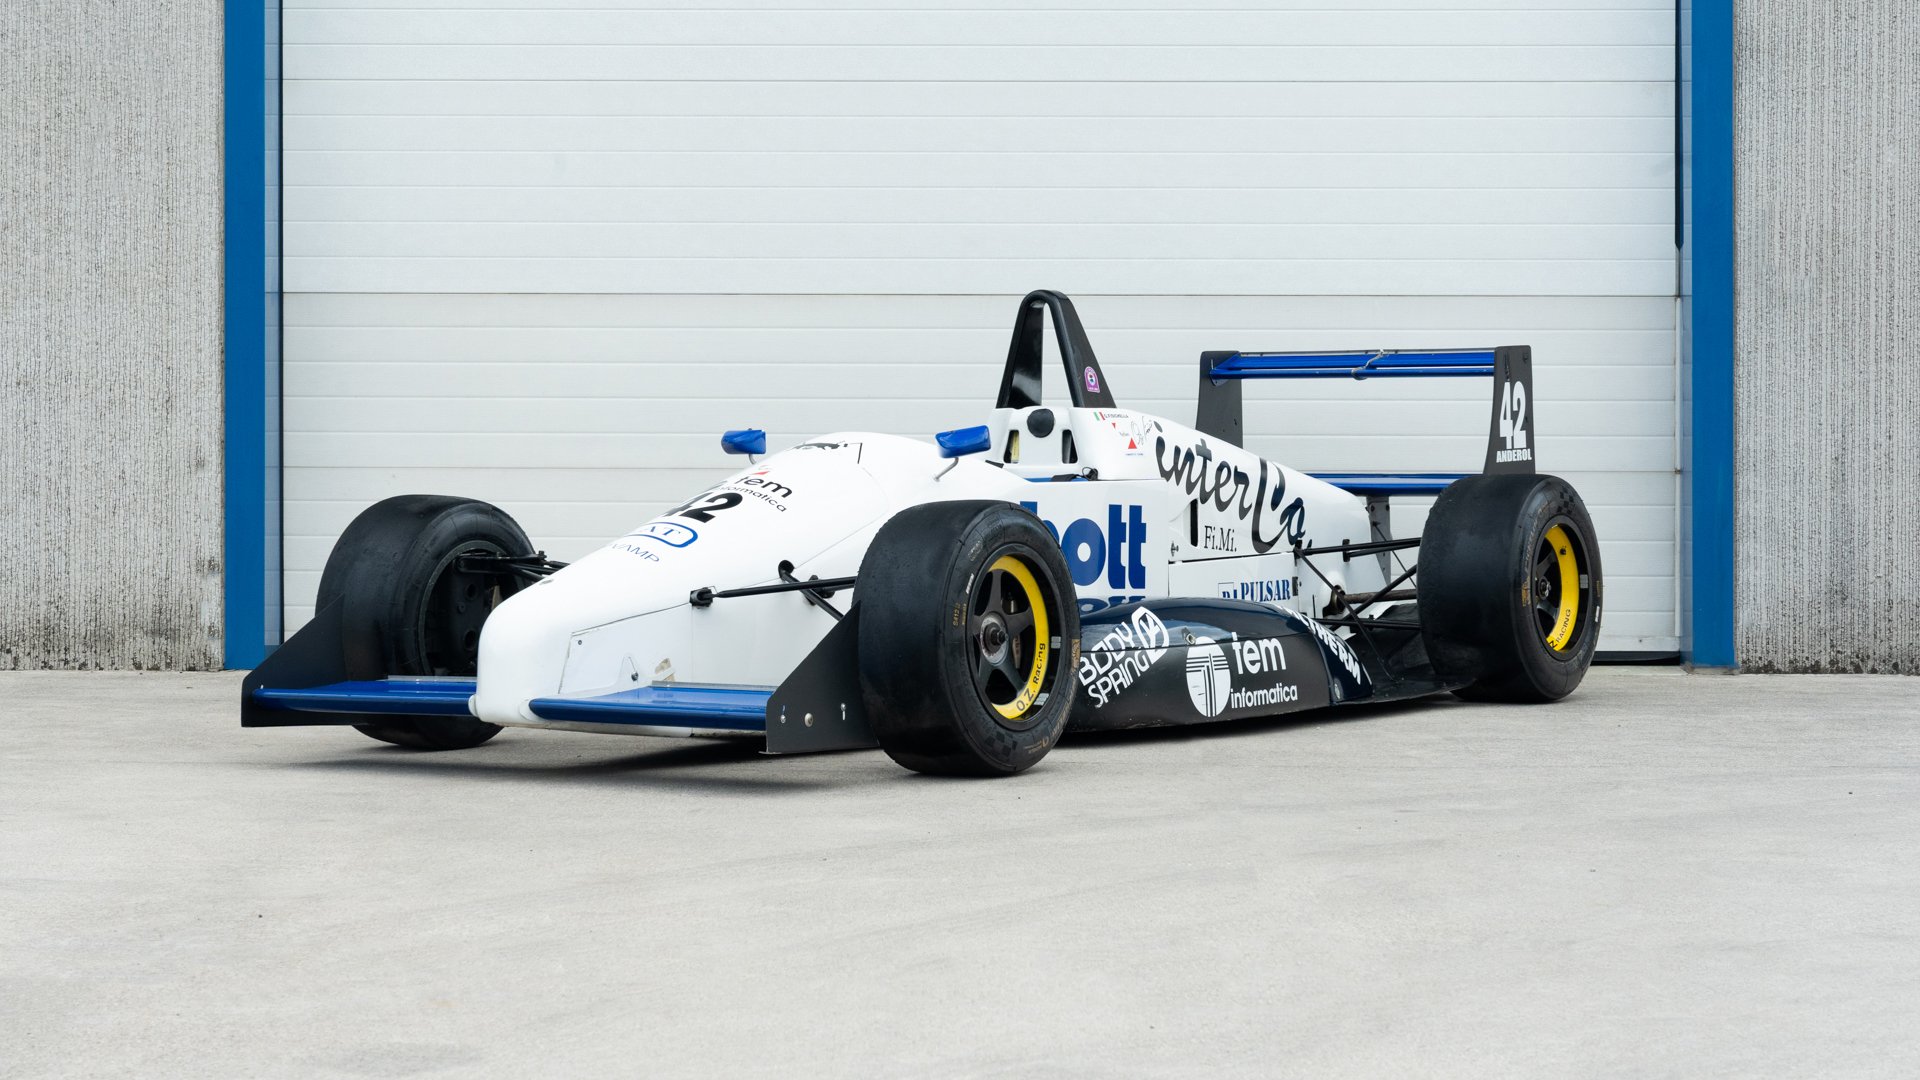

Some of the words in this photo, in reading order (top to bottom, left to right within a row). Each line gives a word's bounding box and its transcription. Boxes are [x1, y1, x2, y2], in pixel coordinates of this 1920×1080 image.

[1499, 380, 1527, 450] 42
[1496, 448, 1533, 463] ANDEROL
[1203, 525, 1238, 553] Fi.Mi.
[1239, 578, 1291, 604] PULSAR
[1555, 608, 1572, 644] RACING
[1078, 621, 1137, 687] BODY
[1016, 687, 1037, 712] O.Z.
[1032, 642, 1046, 685] Racing
[1087, 645, 1150, 709] SPRING
[1230, 682, 1299, 710] informatica
